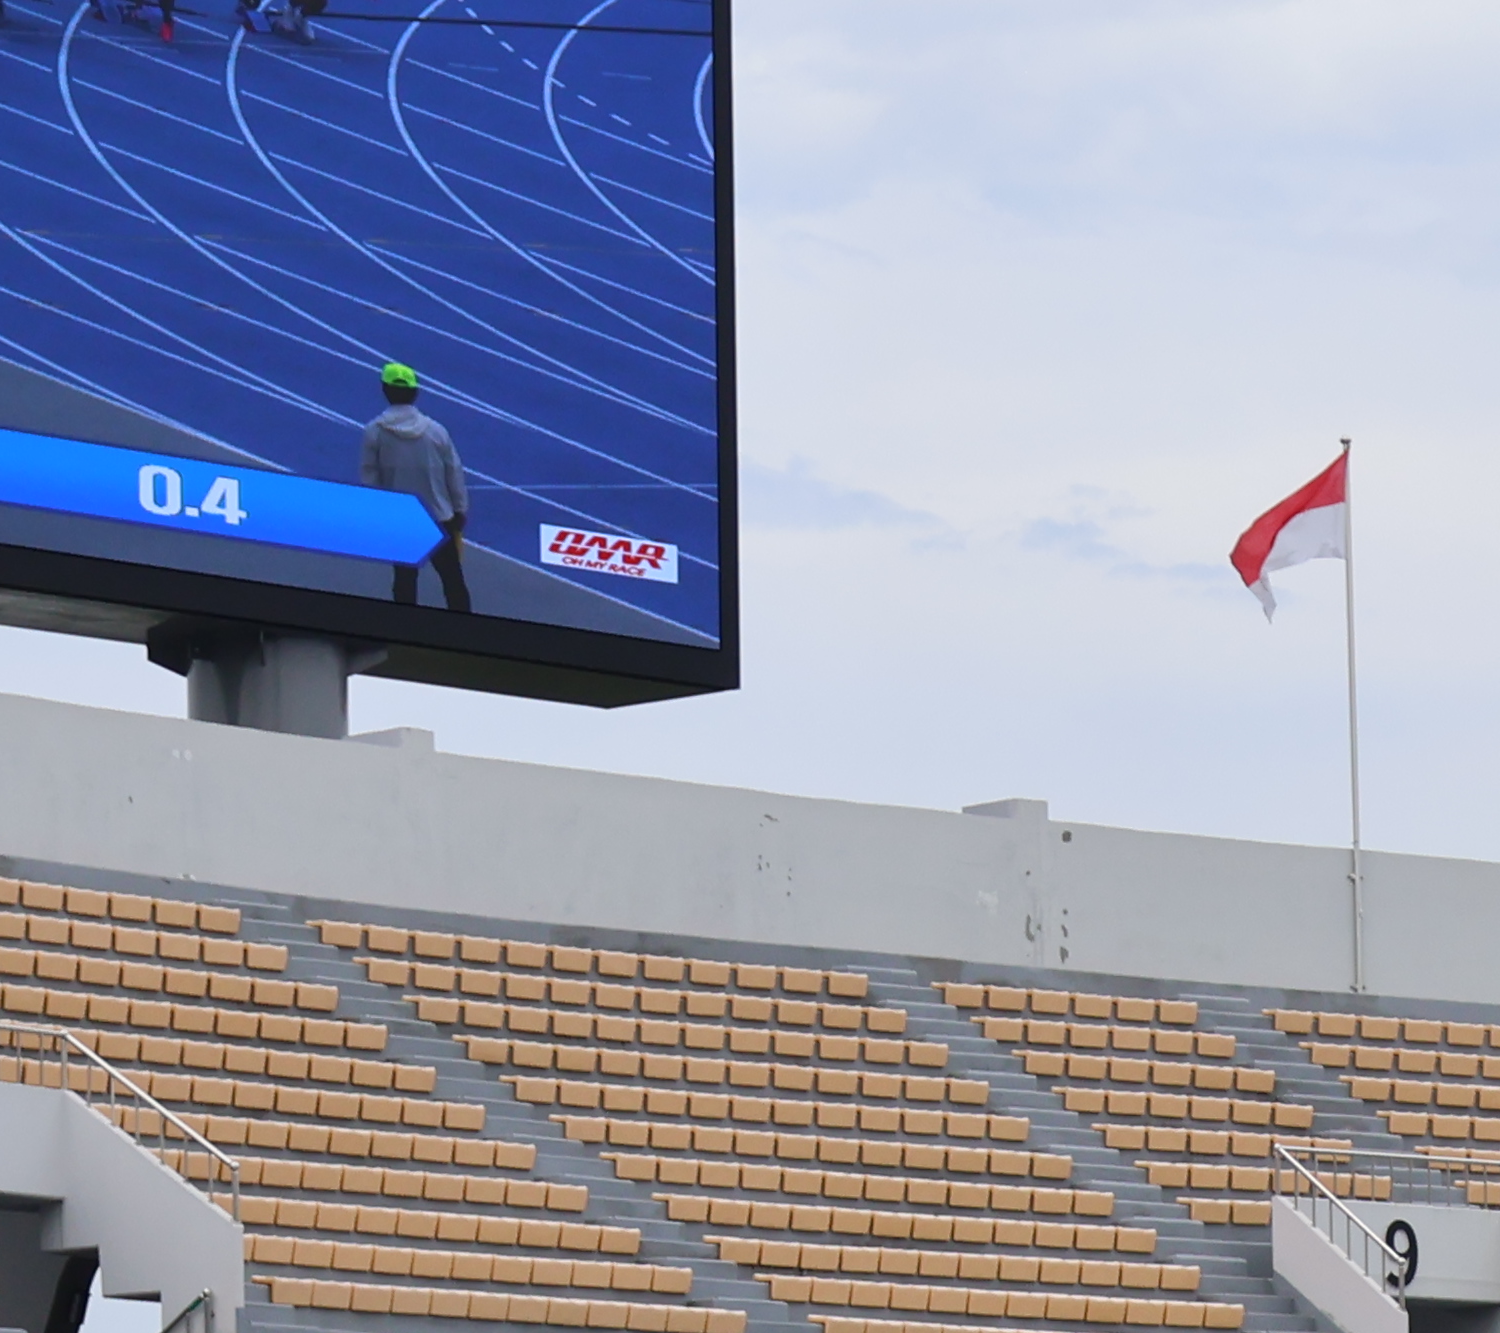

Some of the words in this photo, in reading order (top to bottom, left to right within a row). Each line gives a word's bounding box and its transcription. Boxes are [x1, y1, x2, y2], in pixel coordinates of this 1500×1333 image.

[138, 464, 248, 526] 0.4
[585, 559, 607, 571] MY
[608, 563, 647, 577] RACE
[1384, 1219, 1419, 1288] 9
